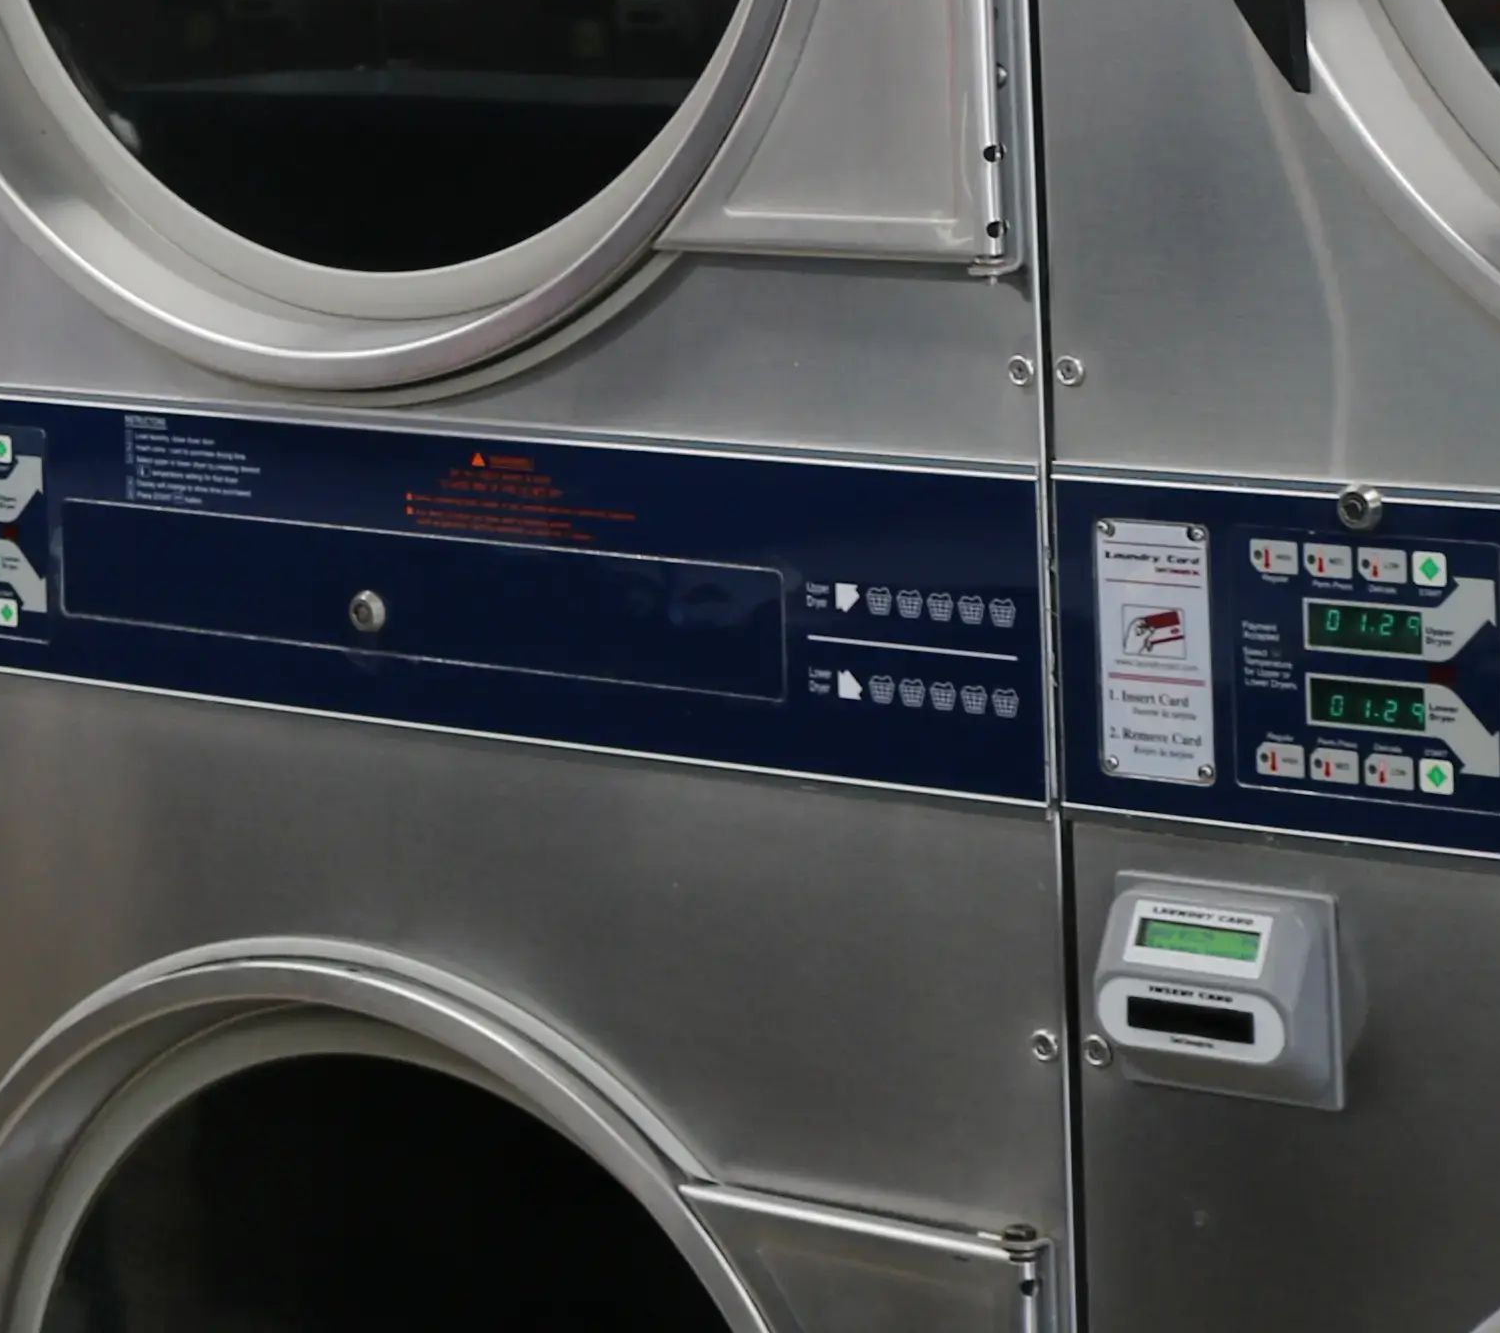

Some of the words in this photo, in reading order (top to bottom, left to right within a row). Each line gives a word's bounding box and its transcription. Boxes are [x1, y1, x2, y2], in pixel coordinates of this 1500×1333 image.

[1104, 550, 1161, 564] Laundry
[1166, 553, 1201, 566] Card
[1121, 690, 1156, 706] Insert
[1158, 692, 1191, 709] Card
[1121, 726, 1170, 744] Remove
[1171, 730, 1204, 748] Card
[1152, 905, 1214, 921] LAUNDRY
[1217, 914, 1255, 927] CARD
[1148, 985, 1195, 998] INSERT
[1198, 991, 1233, 1004] CARD
